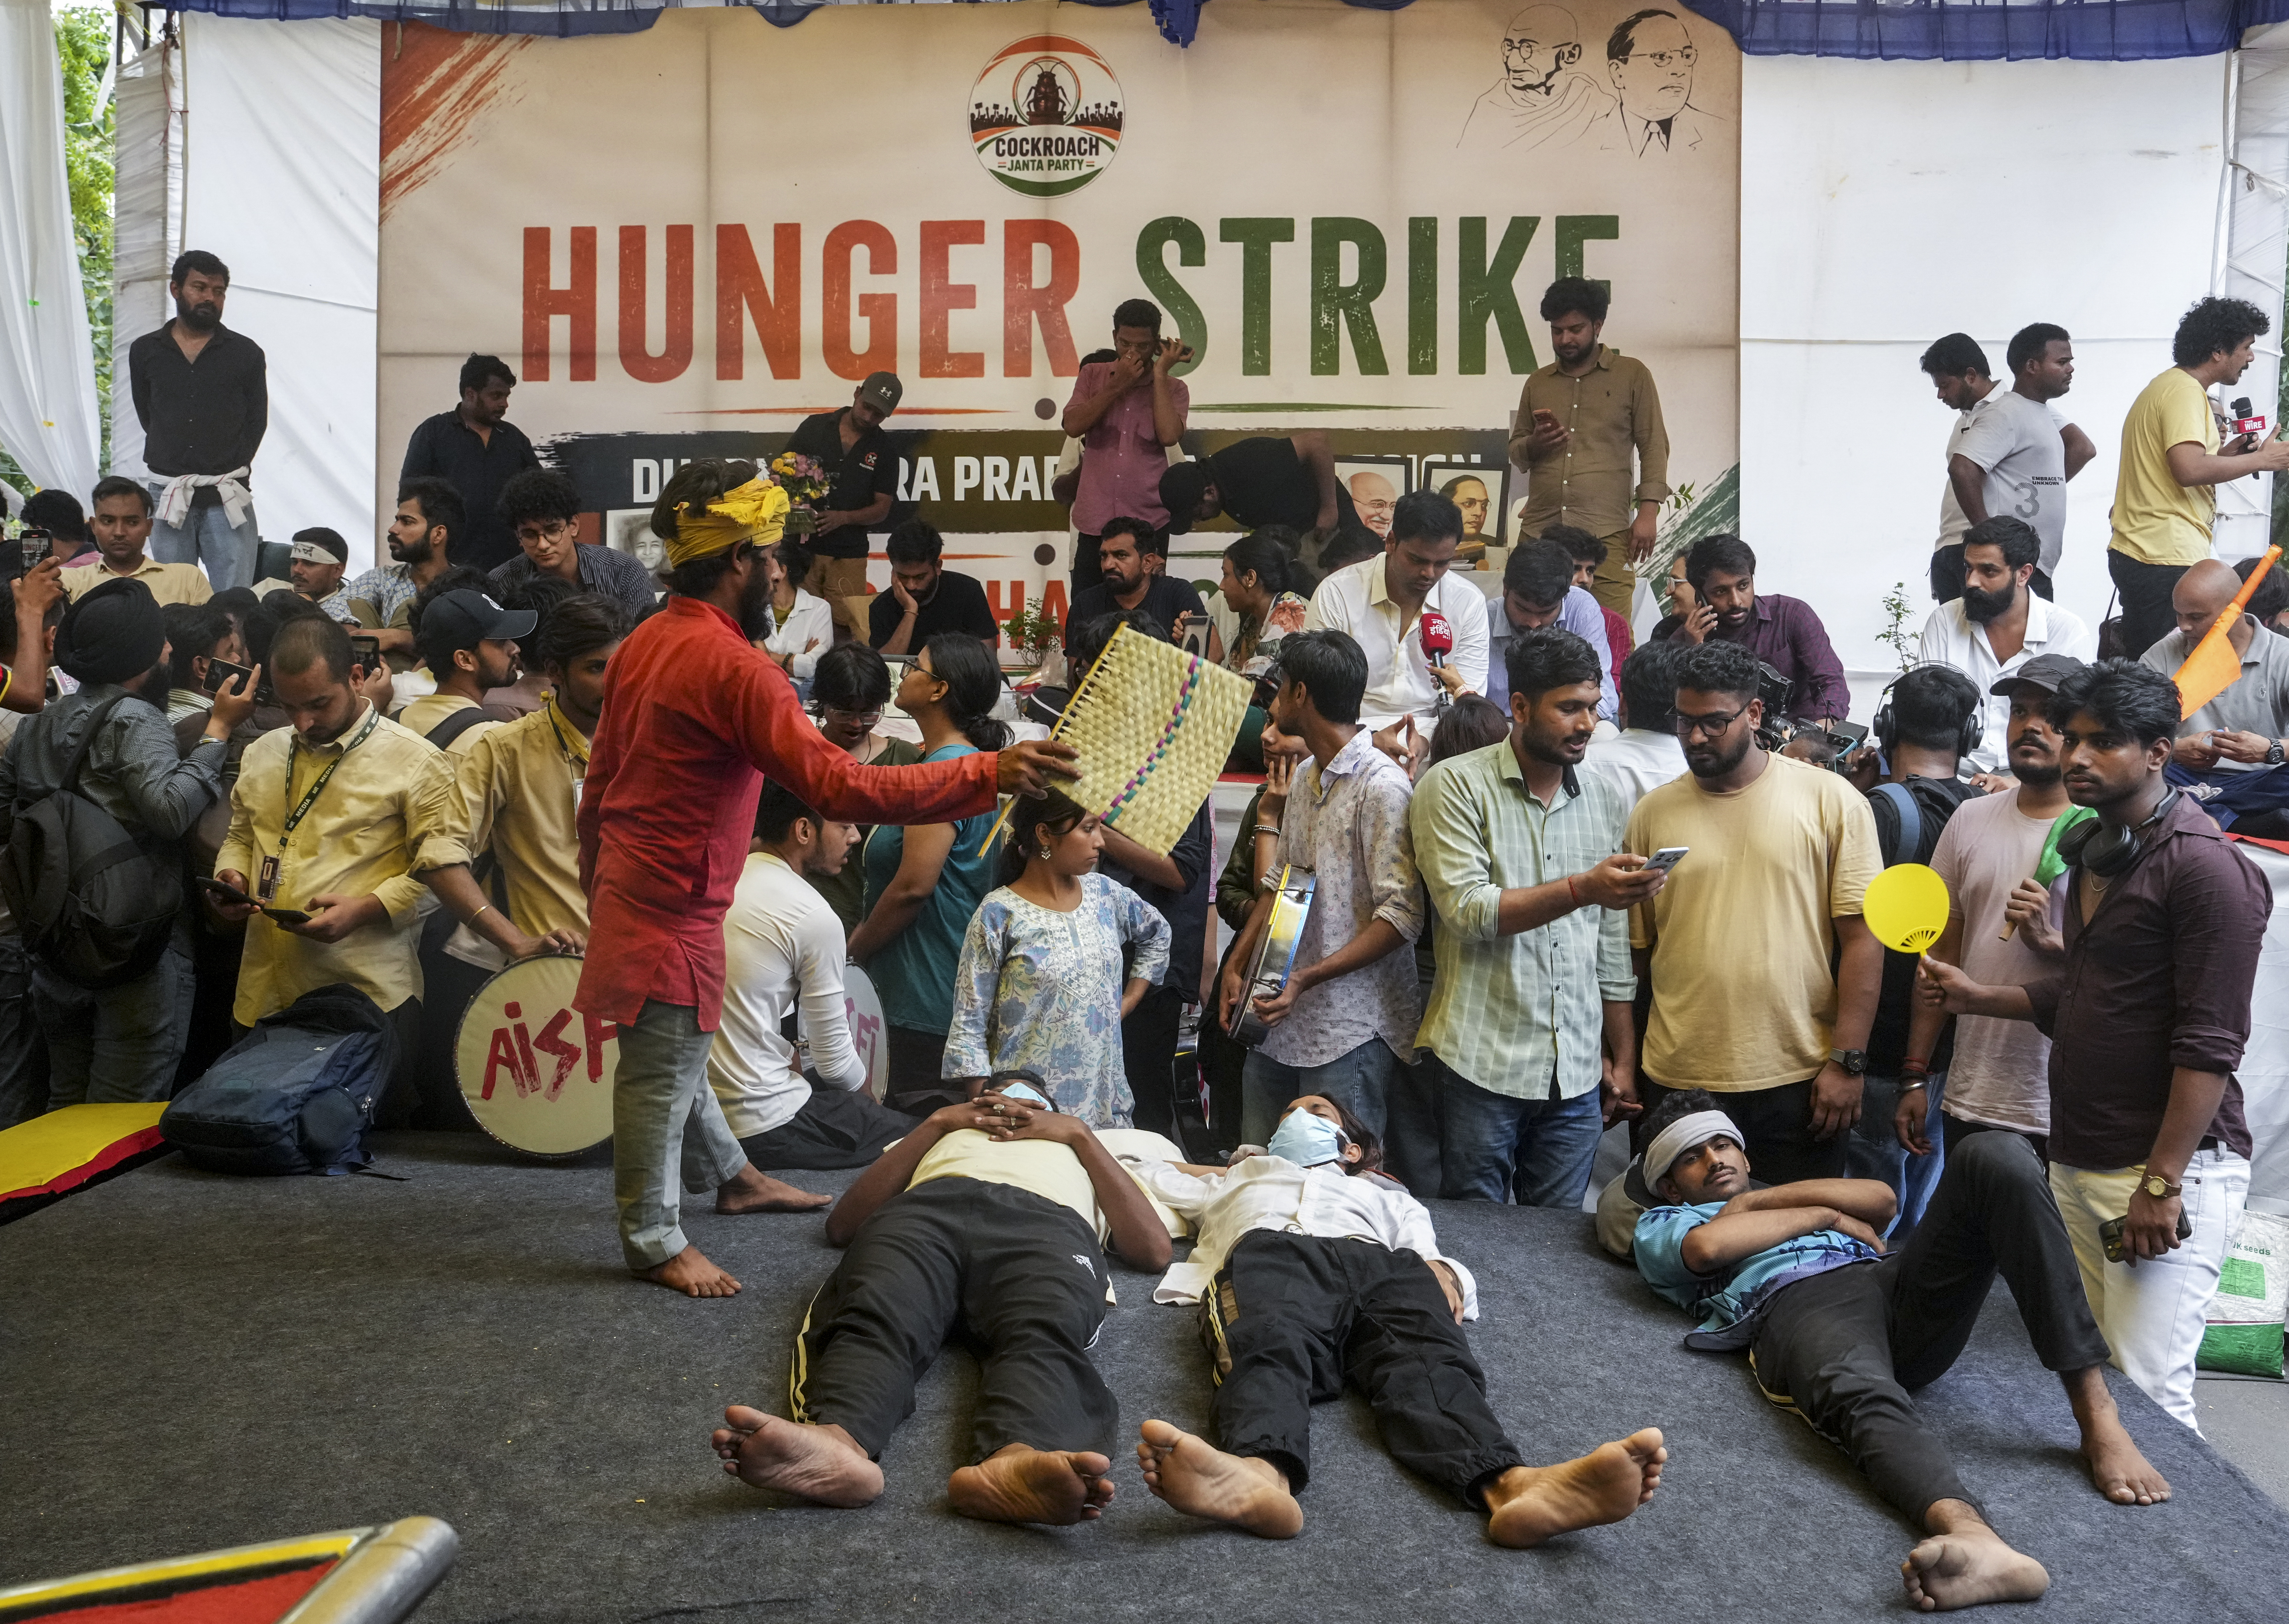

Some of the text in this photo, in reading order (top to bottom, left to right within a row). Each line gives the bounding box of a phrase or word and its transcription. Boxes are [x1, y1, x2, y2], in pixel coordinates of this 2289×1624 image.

[995, 137, 1099, 157] COCKROACH
[1008, 159, 1084, 171] JANTA PARTY
[522, 218, 1081, 383] HUNGER
[2244, 421, 2262, 431] WIRE
[2014, 482, 2040, 518] 3
[296, 798, 311, 817] MEDIA
[320, 764, 334, 783] MEDIA
[2244, 1245, 2271, 1255] seeds
